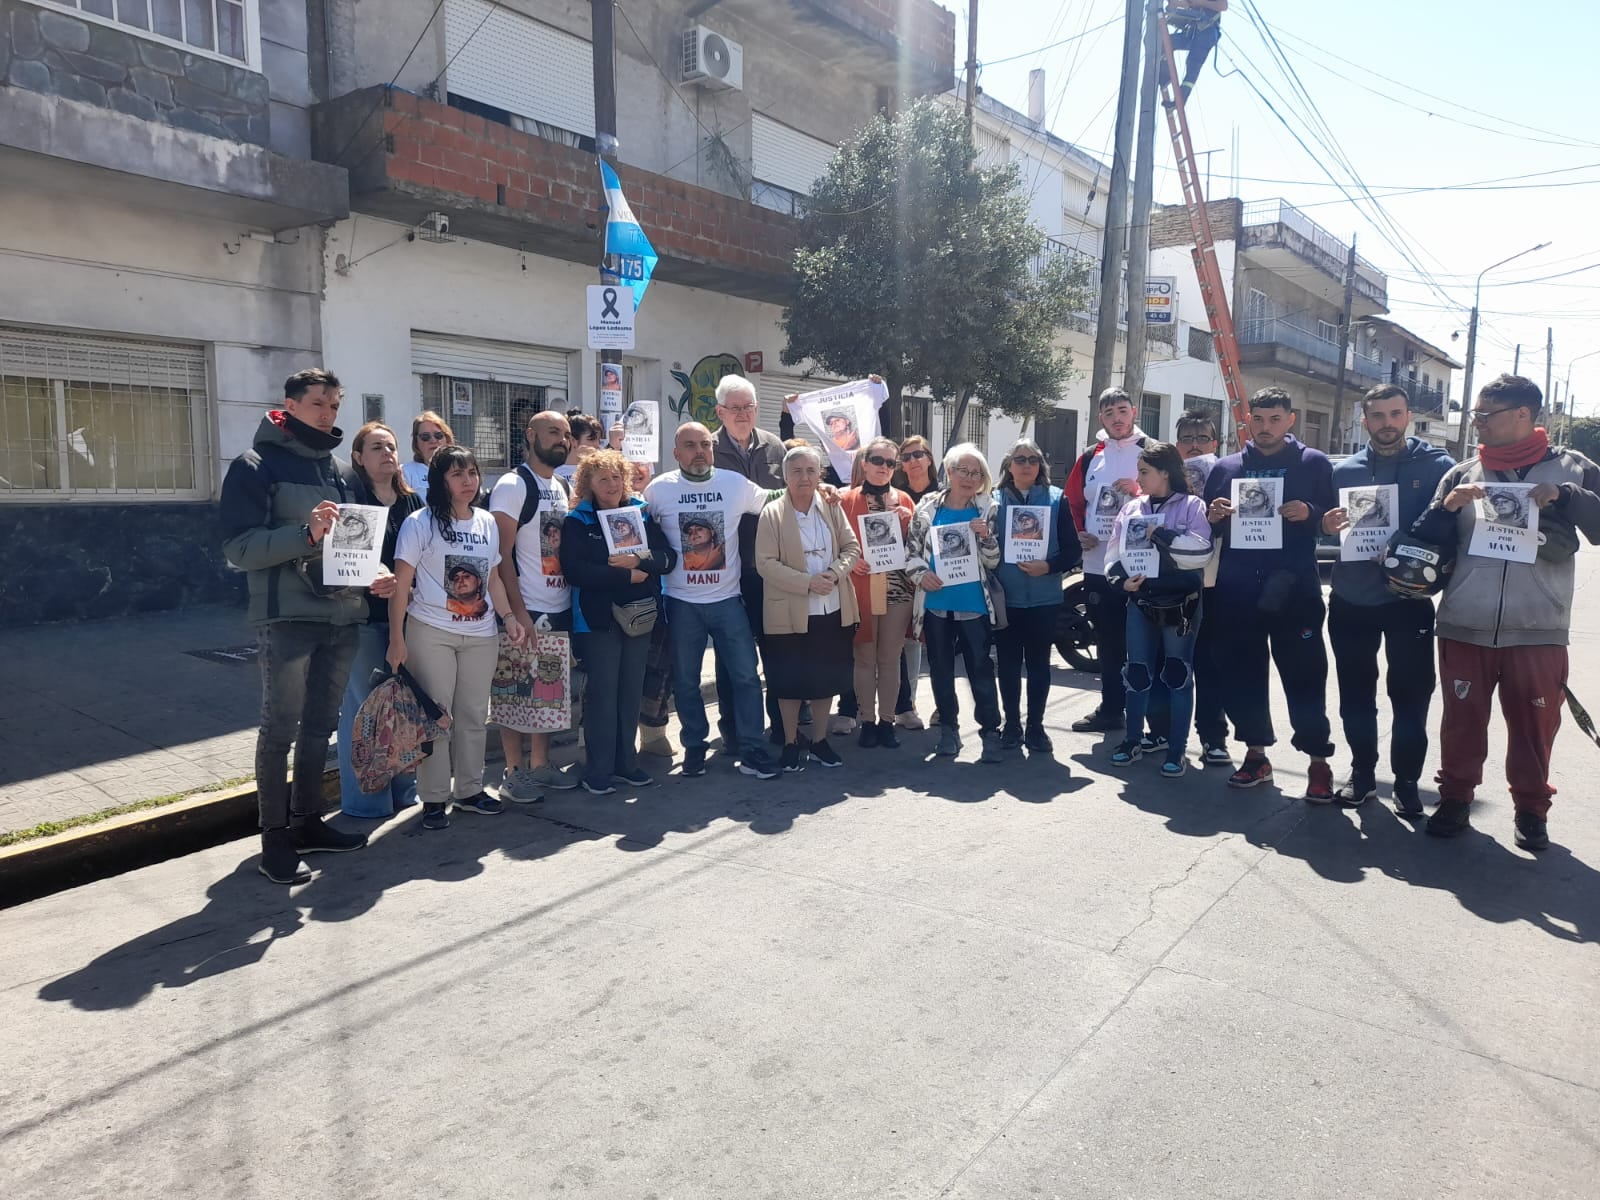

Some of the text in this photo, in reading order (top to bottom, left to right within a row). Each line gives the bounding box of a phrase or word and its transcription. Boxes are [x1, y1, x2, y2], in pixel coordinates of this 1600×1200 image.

[818, 391, 855, 404] JUSTICIA
[678, 492, 723, 504] JUSTICIA
[1487, 526, 1526, 536] JUSTICIA
[463, 544, 474, 552] POR
[871, 546, 896, 554] JUSTICIA
[1488, 542, 1519, 552] MANU
[334, 551, 368, 560] JUSTICIA
[1016, 553, 1037, 561] MANU
[875, 559, 894, 567] MANU
[943, 558, 970, 566] JUSTICIA
[337, 568, 362, 577] MANU
[948, 571, 968, 579] MANU
[546, 577, 567, 588] MAN
[686, 573, 720, 585] MANU
